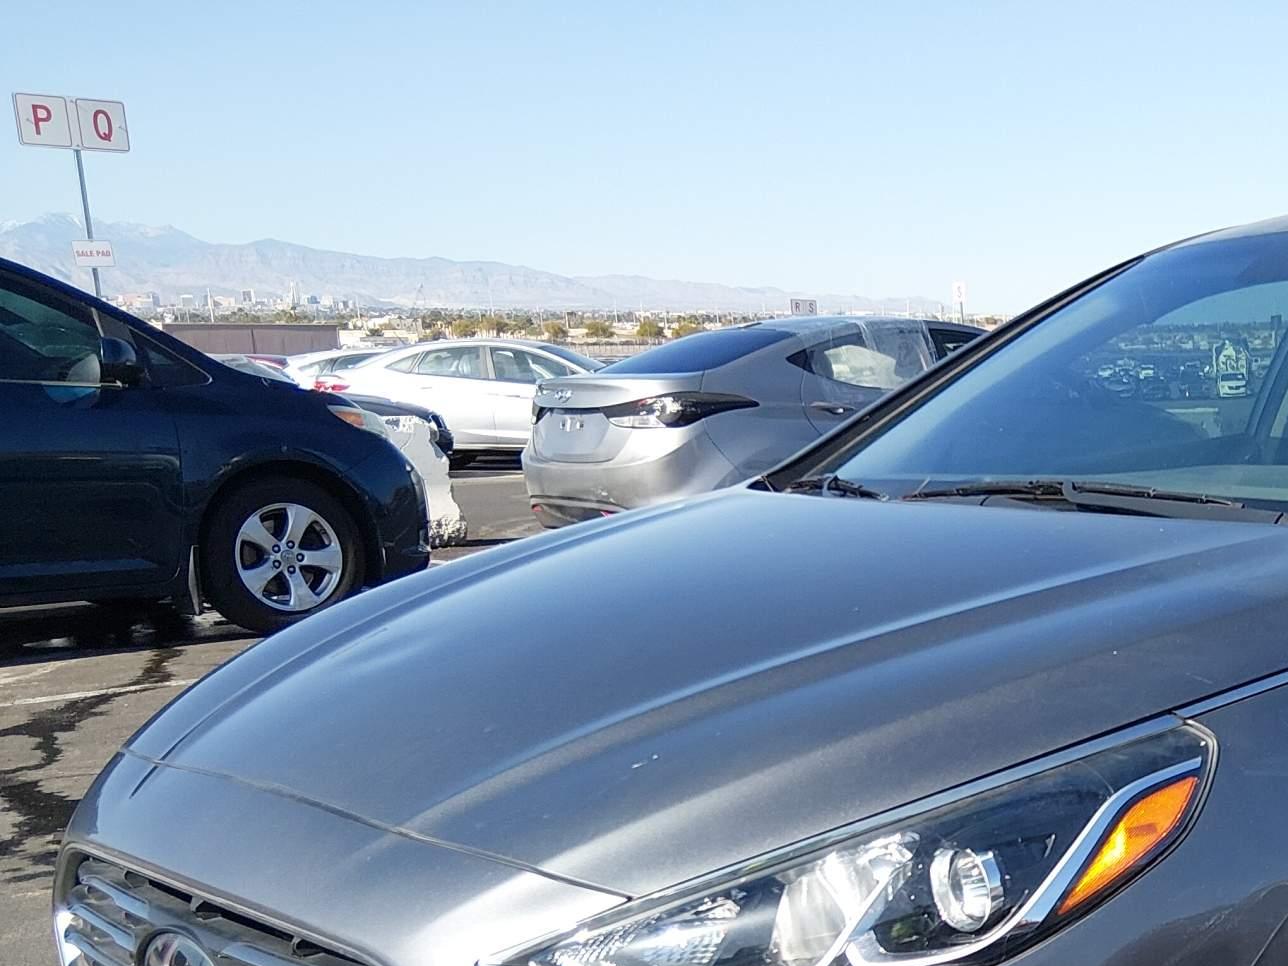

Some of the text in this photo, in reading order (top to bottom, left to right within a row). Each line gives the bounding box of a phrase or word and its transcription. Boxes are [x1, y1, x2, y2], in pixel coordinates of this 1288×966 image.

[31, 103, 113, 142] P Q
[75, 249, 94, 257] SALE
[795, 302, 814, 313] R S
